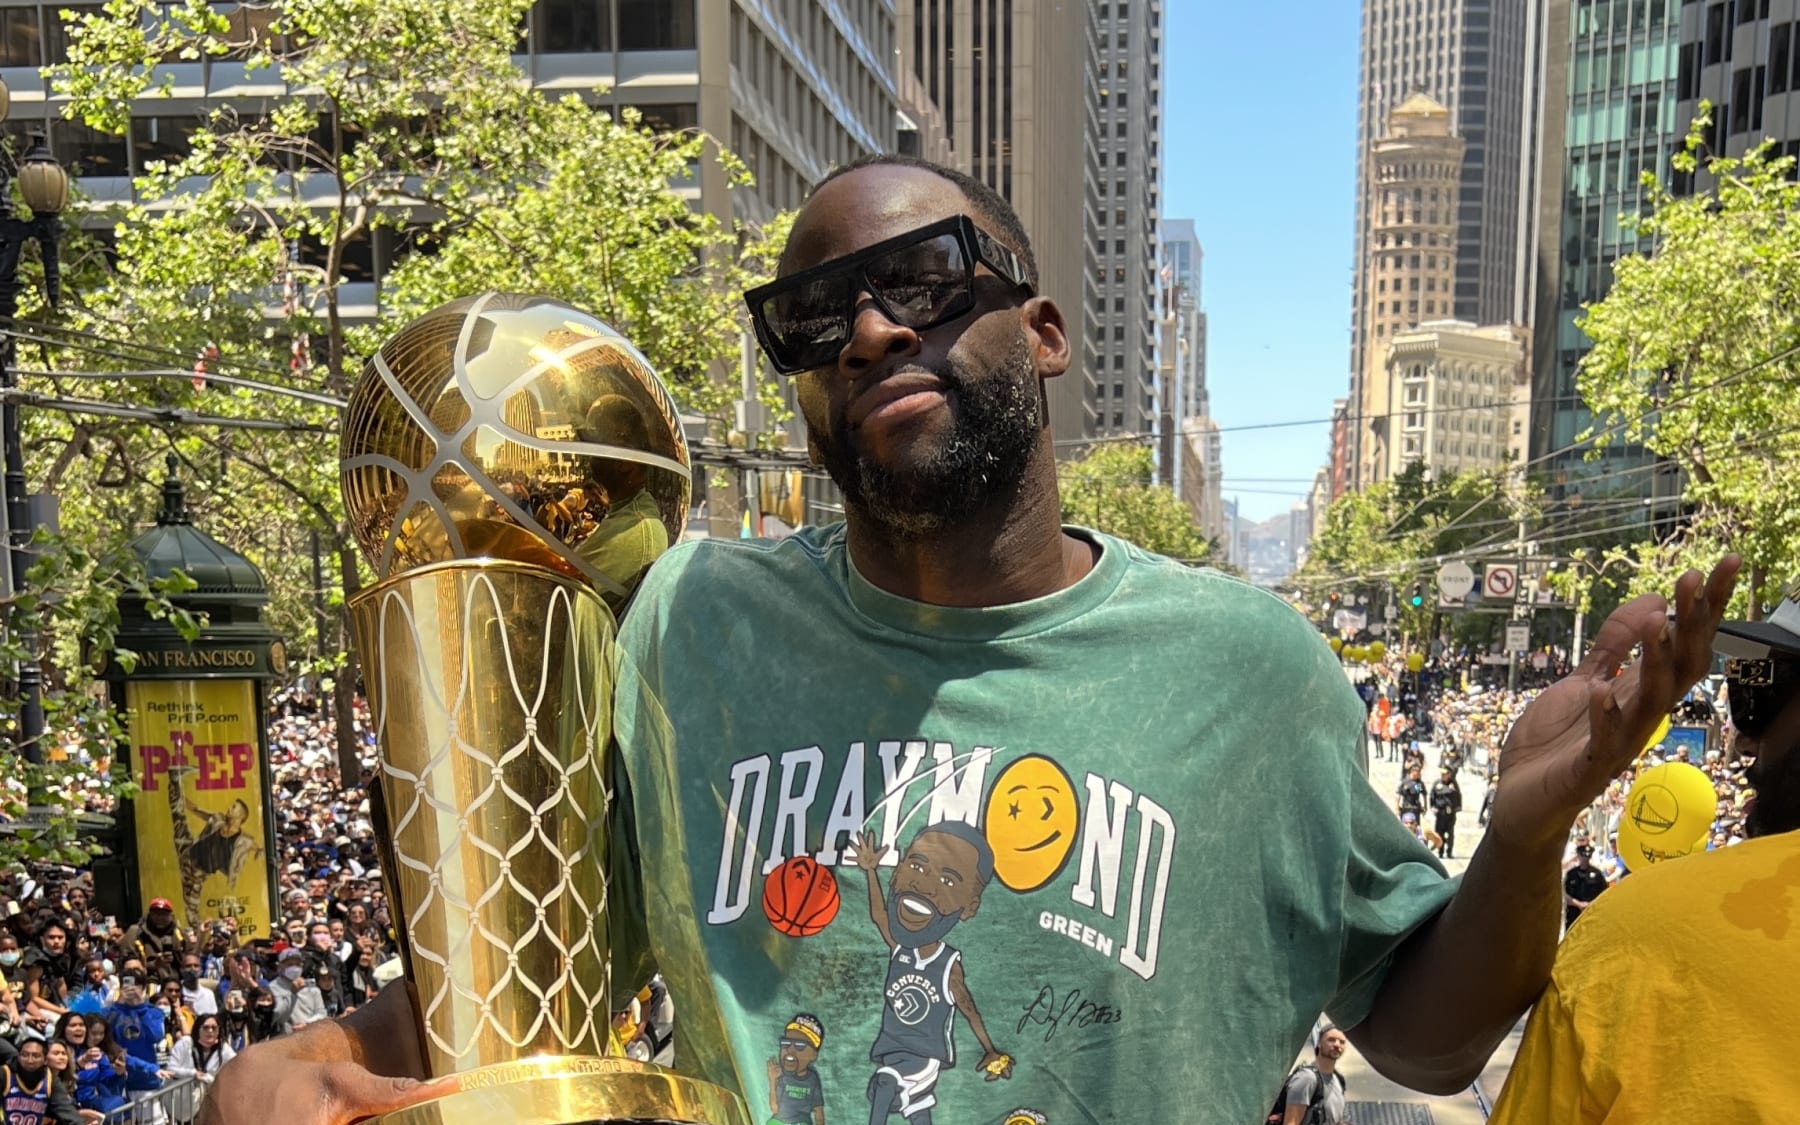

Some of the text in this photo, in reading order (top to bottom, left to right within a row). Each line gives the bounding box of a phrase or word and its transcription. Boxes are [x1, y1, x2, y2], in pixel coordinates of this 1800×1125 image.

[135, 650, 256, 667] AN FRANCISCO
[147, 701, 204, 713] Rethink
[167, 713, 239, 725] PrEP.com
[138, 730, 256, 791] PrEP
[706, 739, 1178, 983] DRAYMOND
[238, 924, 257, 937] EP
[1039, 910, 1114, 958] GREEN
[886, 974, 941, 1004] CONVERSE
